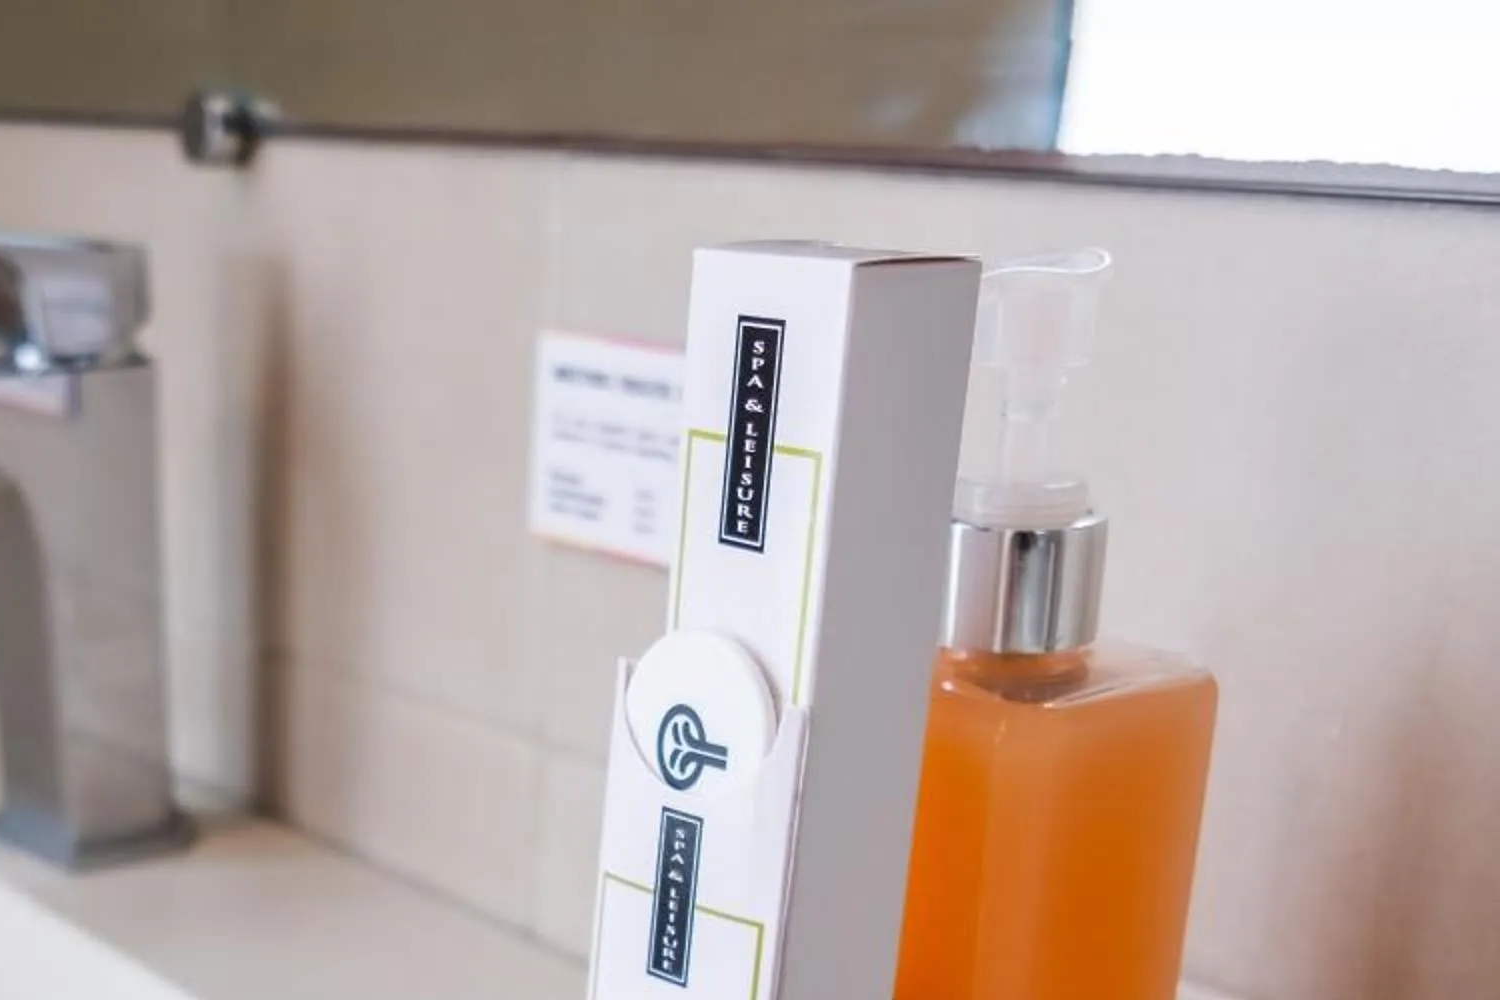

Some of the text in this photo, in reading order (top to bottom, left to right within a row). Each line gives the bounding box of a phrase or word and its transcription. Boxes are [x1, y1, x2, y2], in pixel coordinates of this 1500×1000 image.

[736, 340, 766, 534] SPA & LEISURE
[670, 828, 686, 865] SPA
[662, 888, 680, 972] LEISURE
